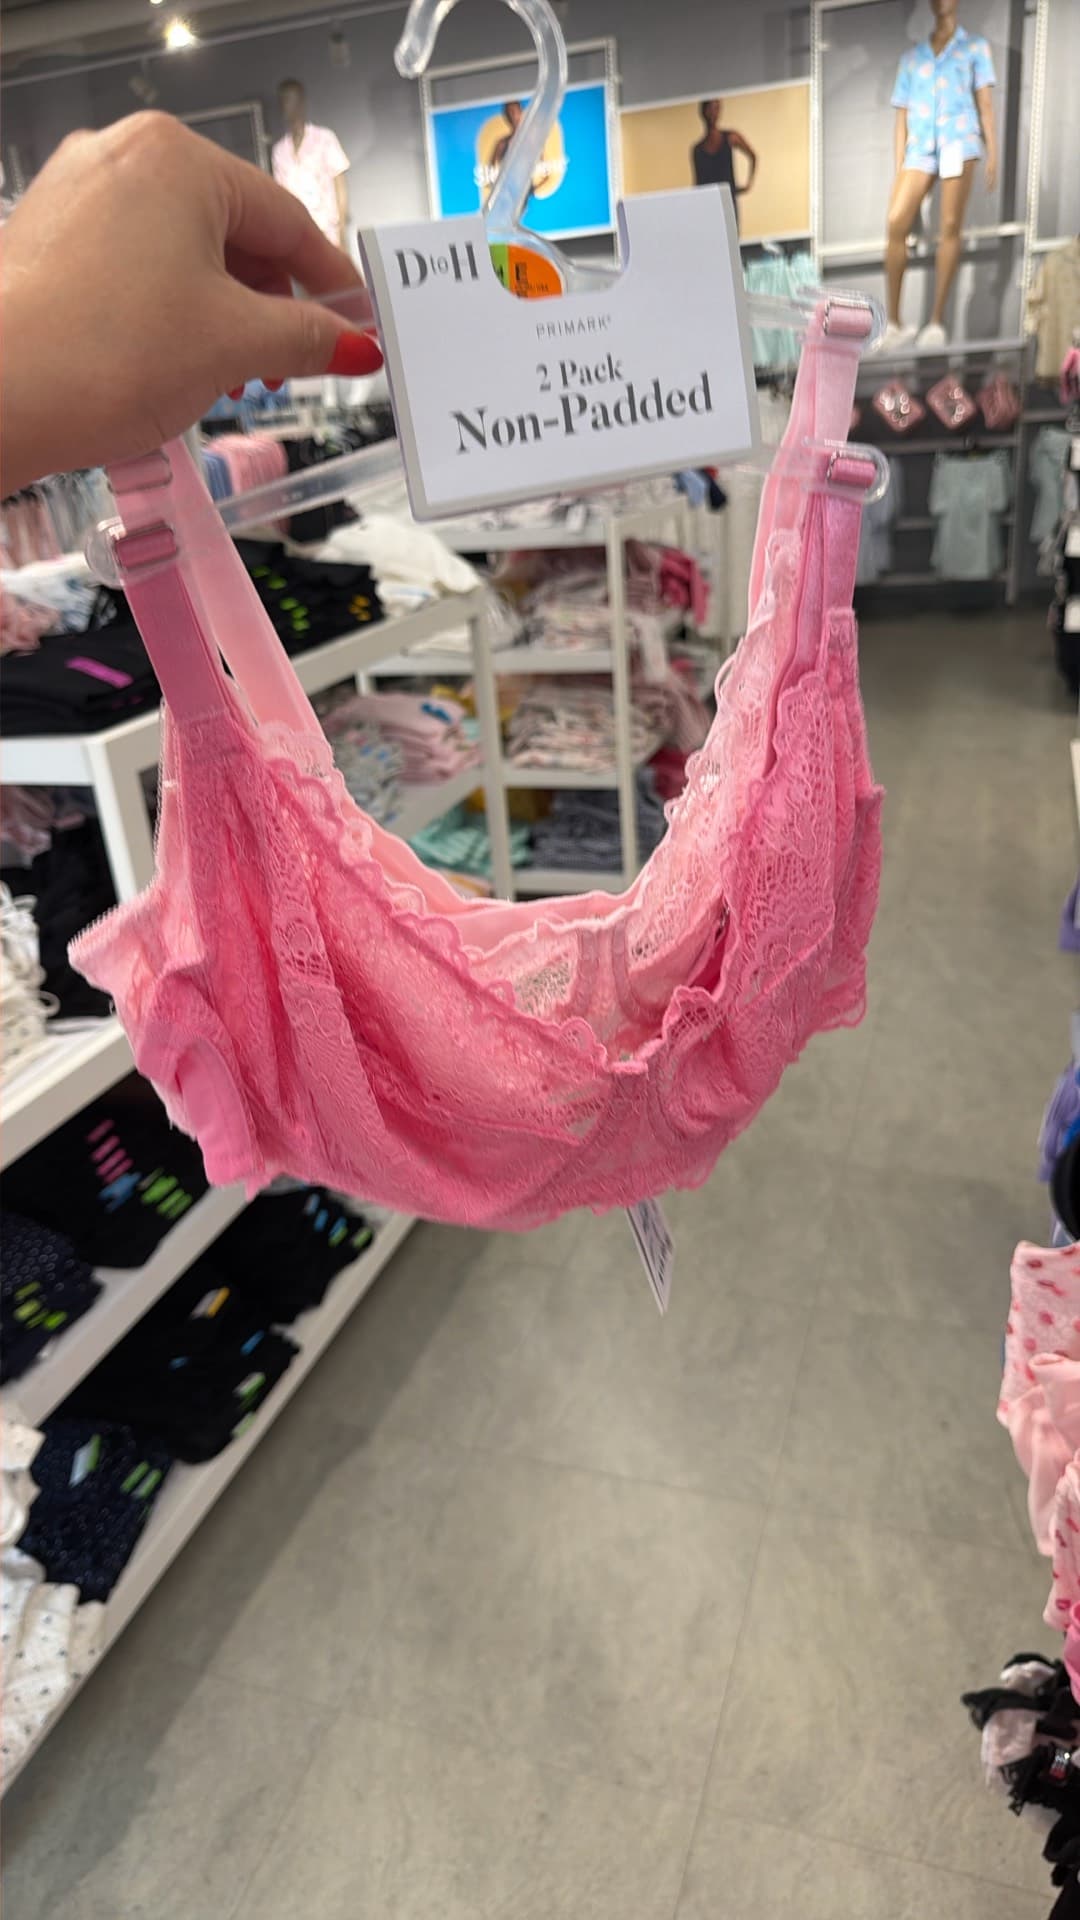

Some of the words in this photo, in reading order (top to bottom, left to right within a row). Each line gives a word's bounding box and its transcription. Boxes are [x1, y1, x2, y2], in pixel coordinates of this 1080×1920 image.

[536, 363, 552, 392] 2
[559, 352, 624, 388] Pack
[450, 371, 713, 453] Non-Padded
